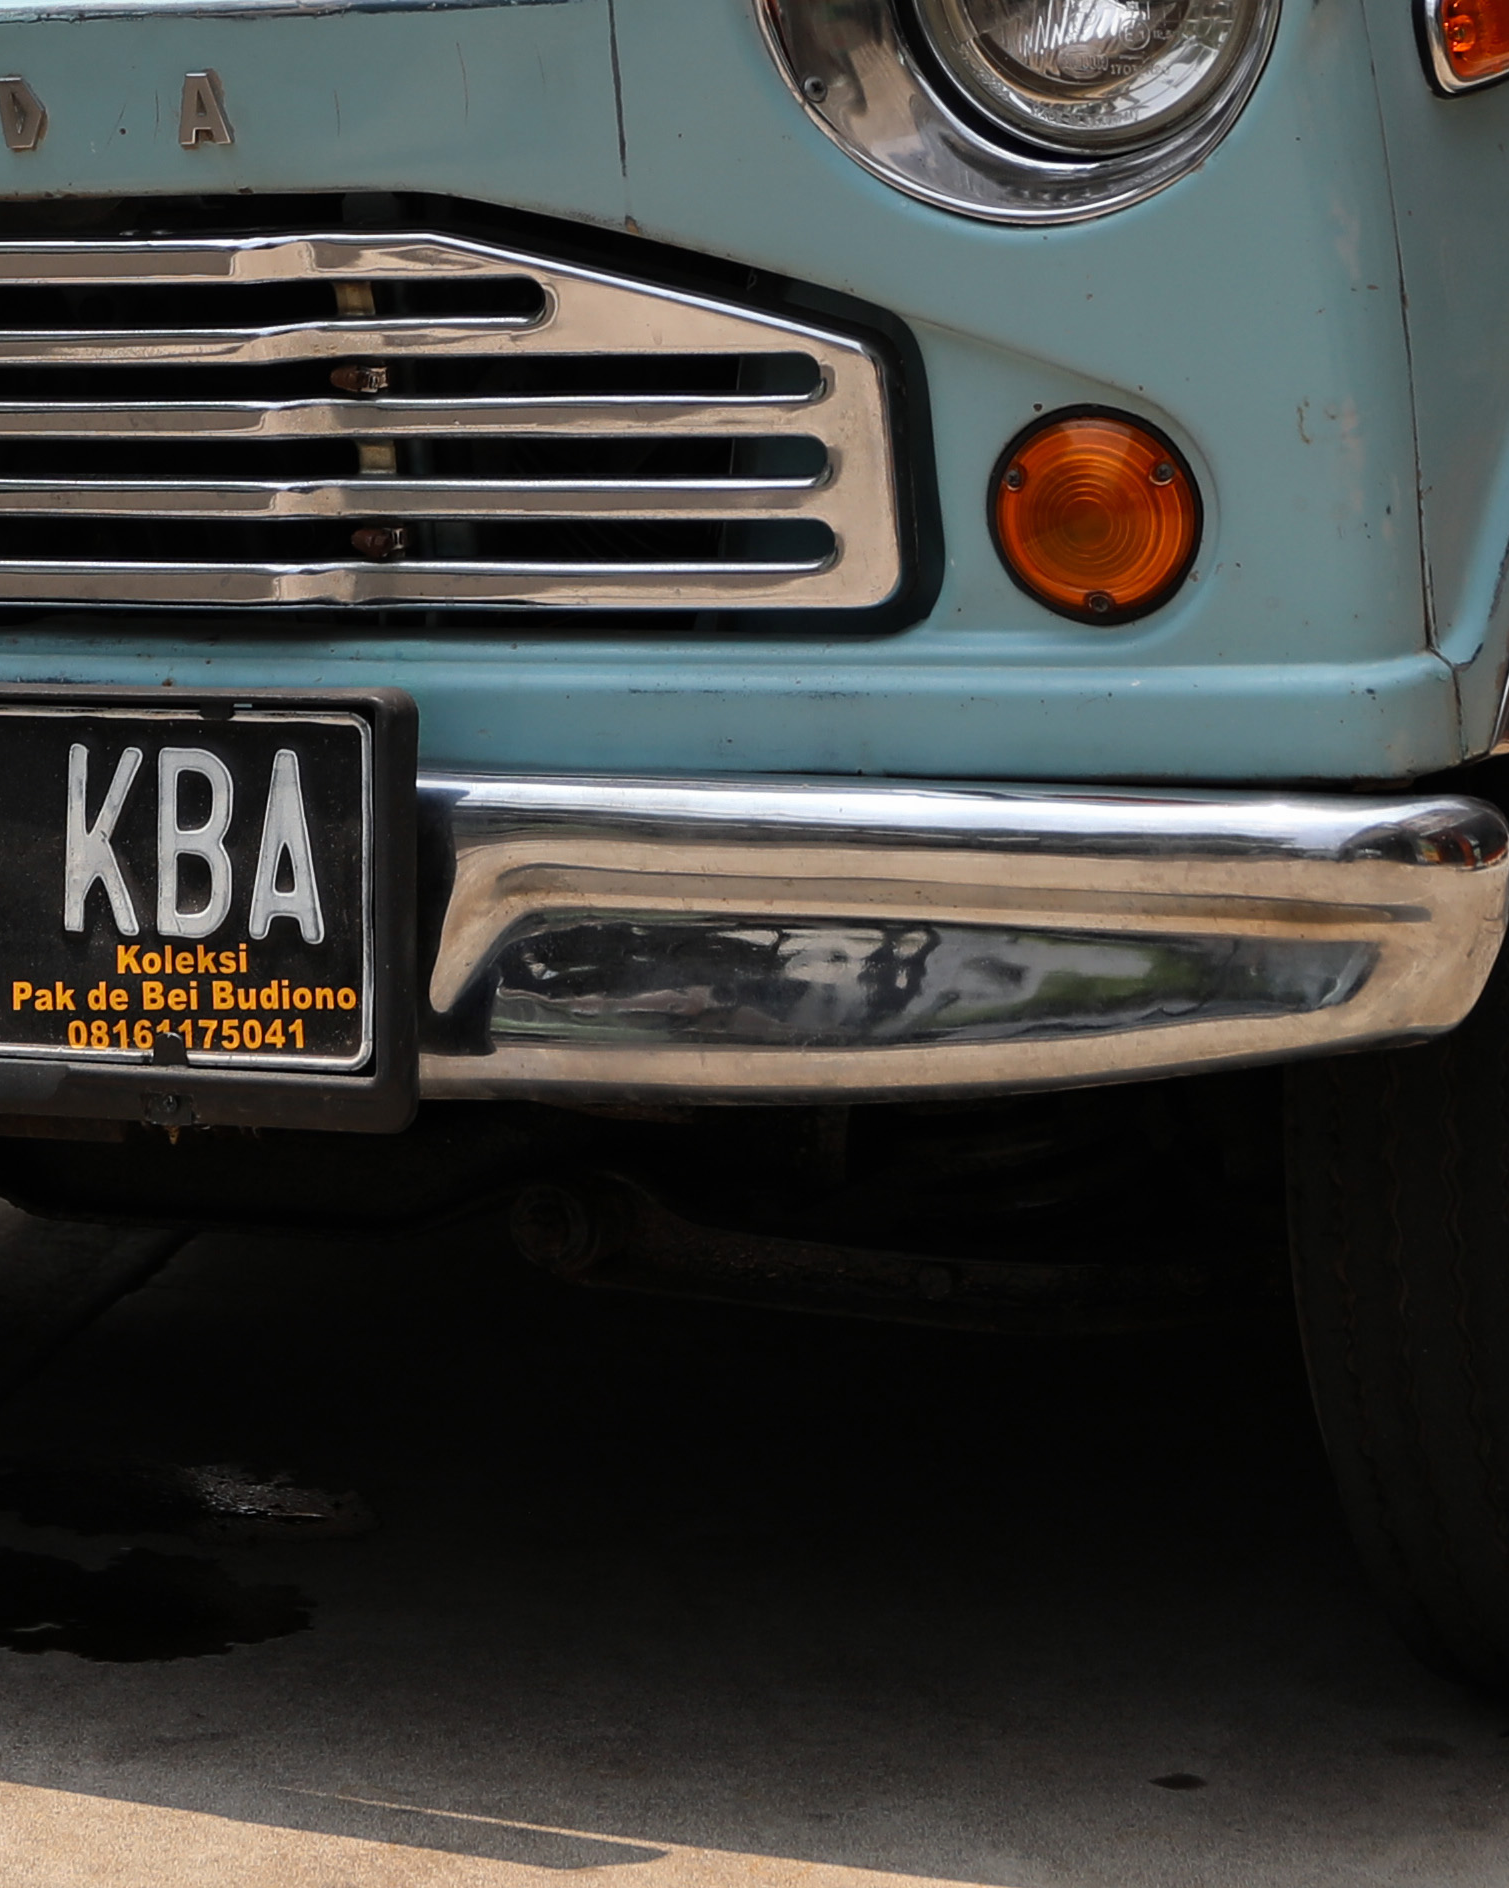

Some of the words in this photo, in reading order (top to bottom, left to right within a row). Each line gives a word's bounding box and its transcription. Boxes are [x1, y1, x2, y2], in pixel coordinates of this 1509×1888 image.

[62, 743, 325, 946] KBA
[116, 944, 248, 974] Koleksi
[12, 980, 76, 1010] Pak
[87, 981, 129, 1010] de
[142, 980, 198, 1010] Bei
[211, 979, 357, 1010] Budiono
